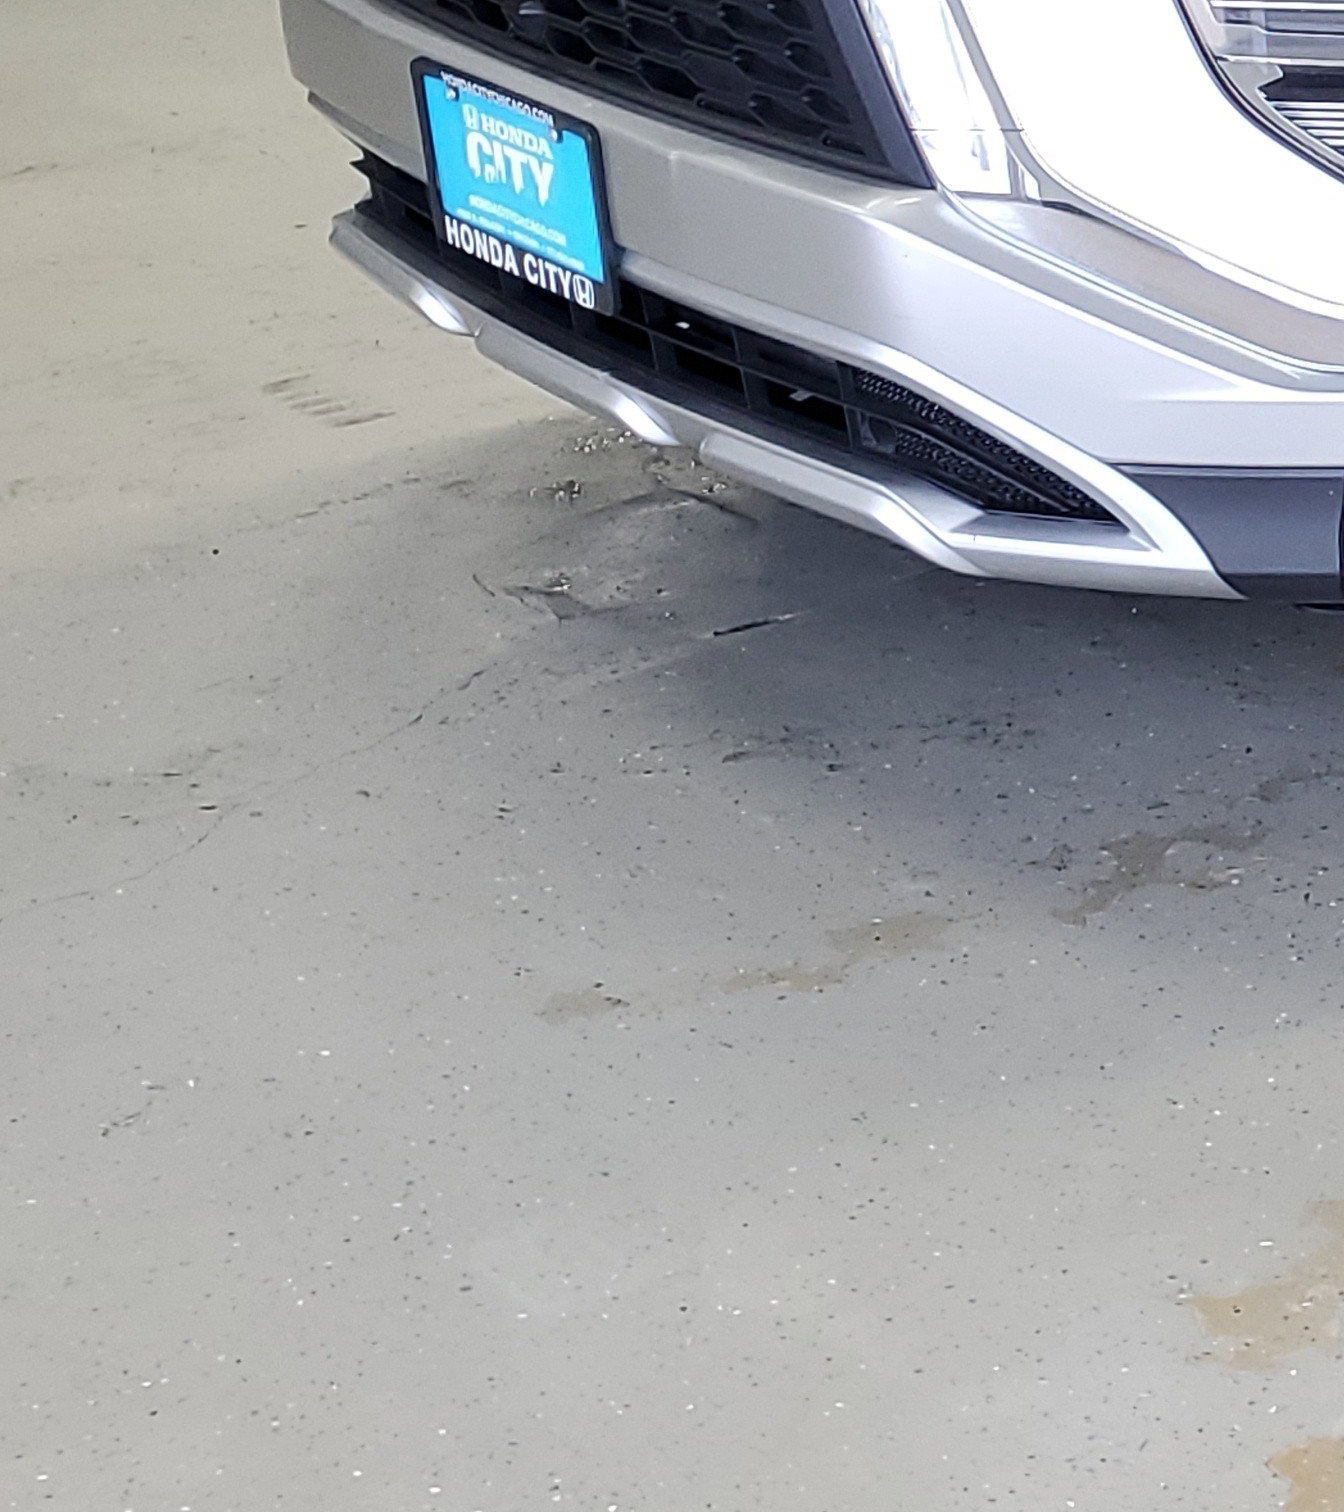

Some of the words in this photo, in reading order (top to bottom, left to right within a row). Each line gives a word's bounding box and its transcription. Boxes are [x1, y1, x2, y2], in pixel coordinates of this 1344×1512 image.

[466, 131, 555, 206] CITY
[480, 112, 555, 160] HONDA
[445, 214, 520, 277] HONDA
[523, 256, 575, 300] CITY
